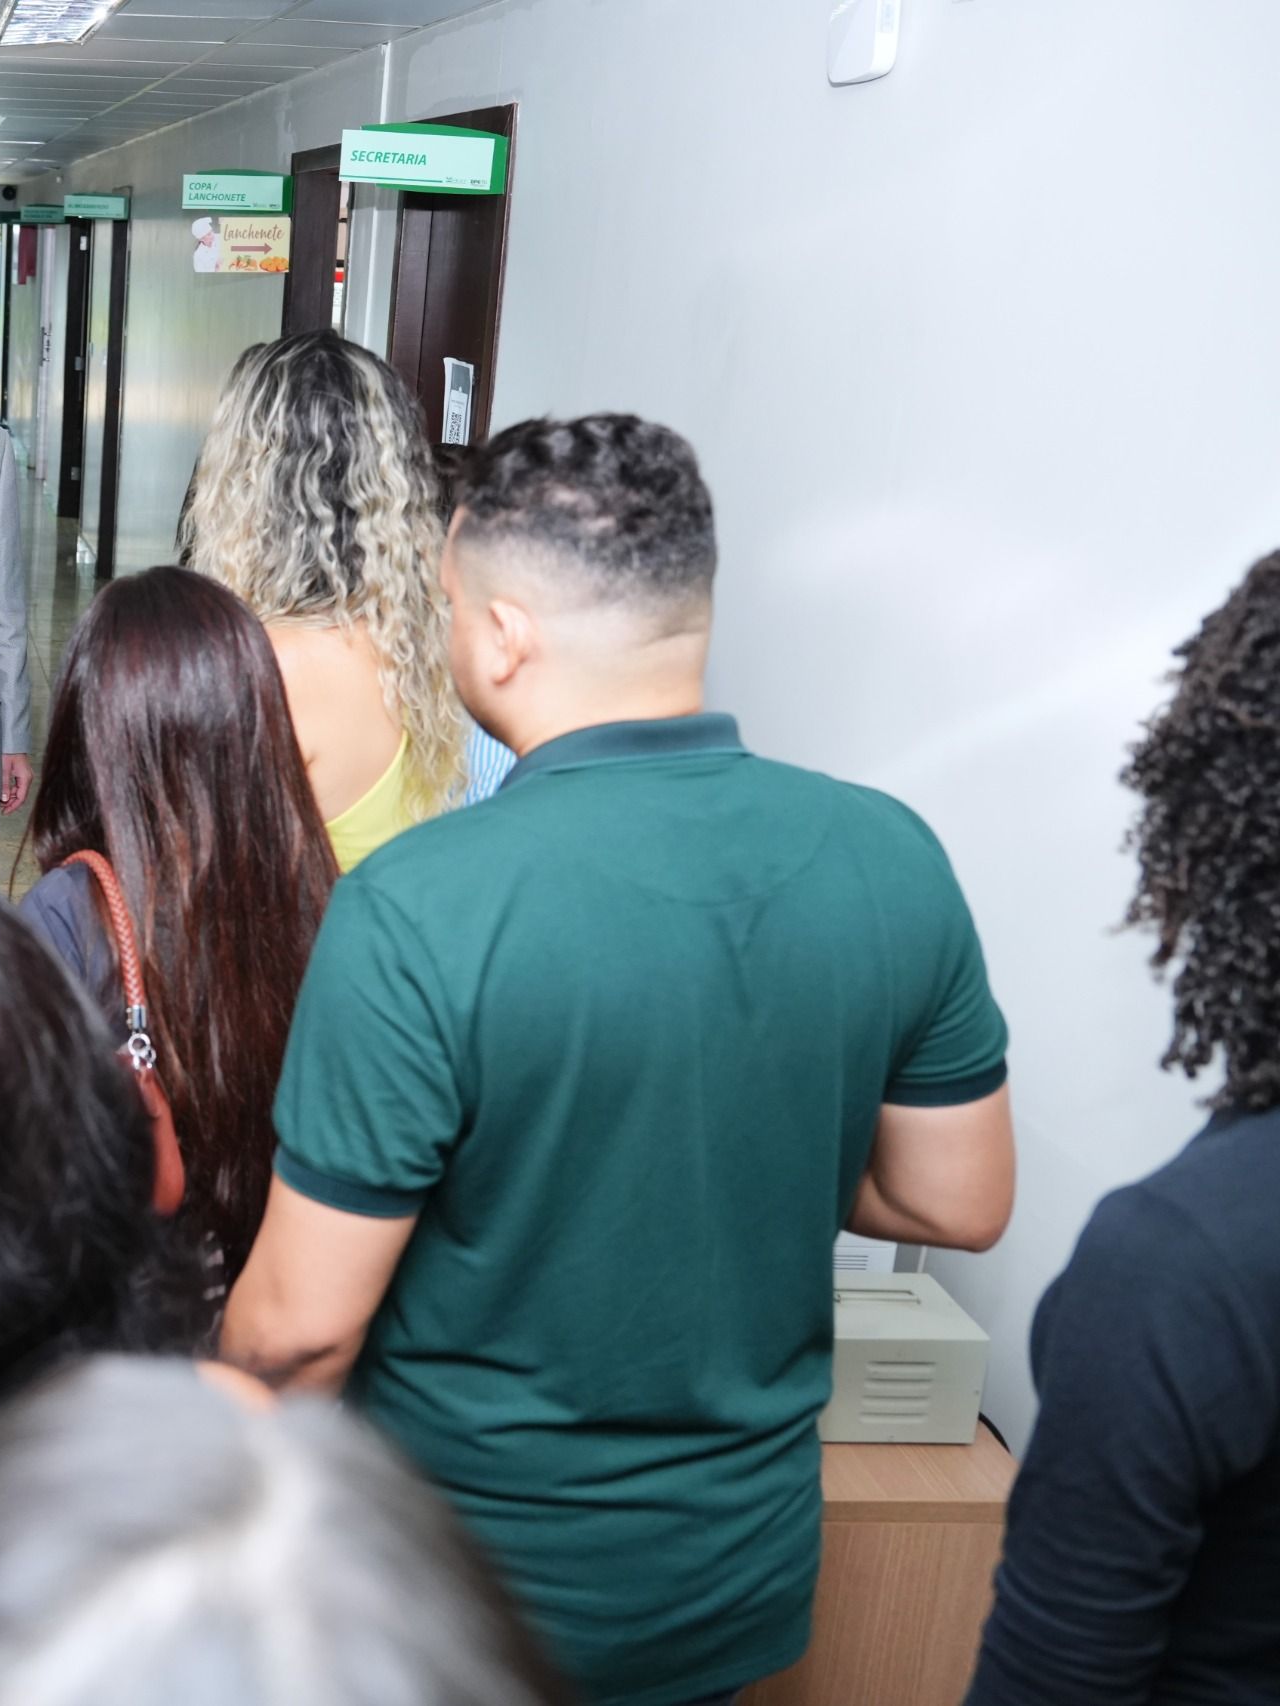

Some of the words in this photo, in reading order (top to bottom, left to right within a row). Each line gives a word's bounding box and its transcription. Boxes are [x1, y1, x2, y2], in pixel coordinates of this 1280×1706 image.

[350, 150, 427, 165] SECRETARIA
[189, 182, 212, 191] COPA
[188, 193, 246, 201] LANCHONETE
[223, 223, 284, 241] Lanchonete
